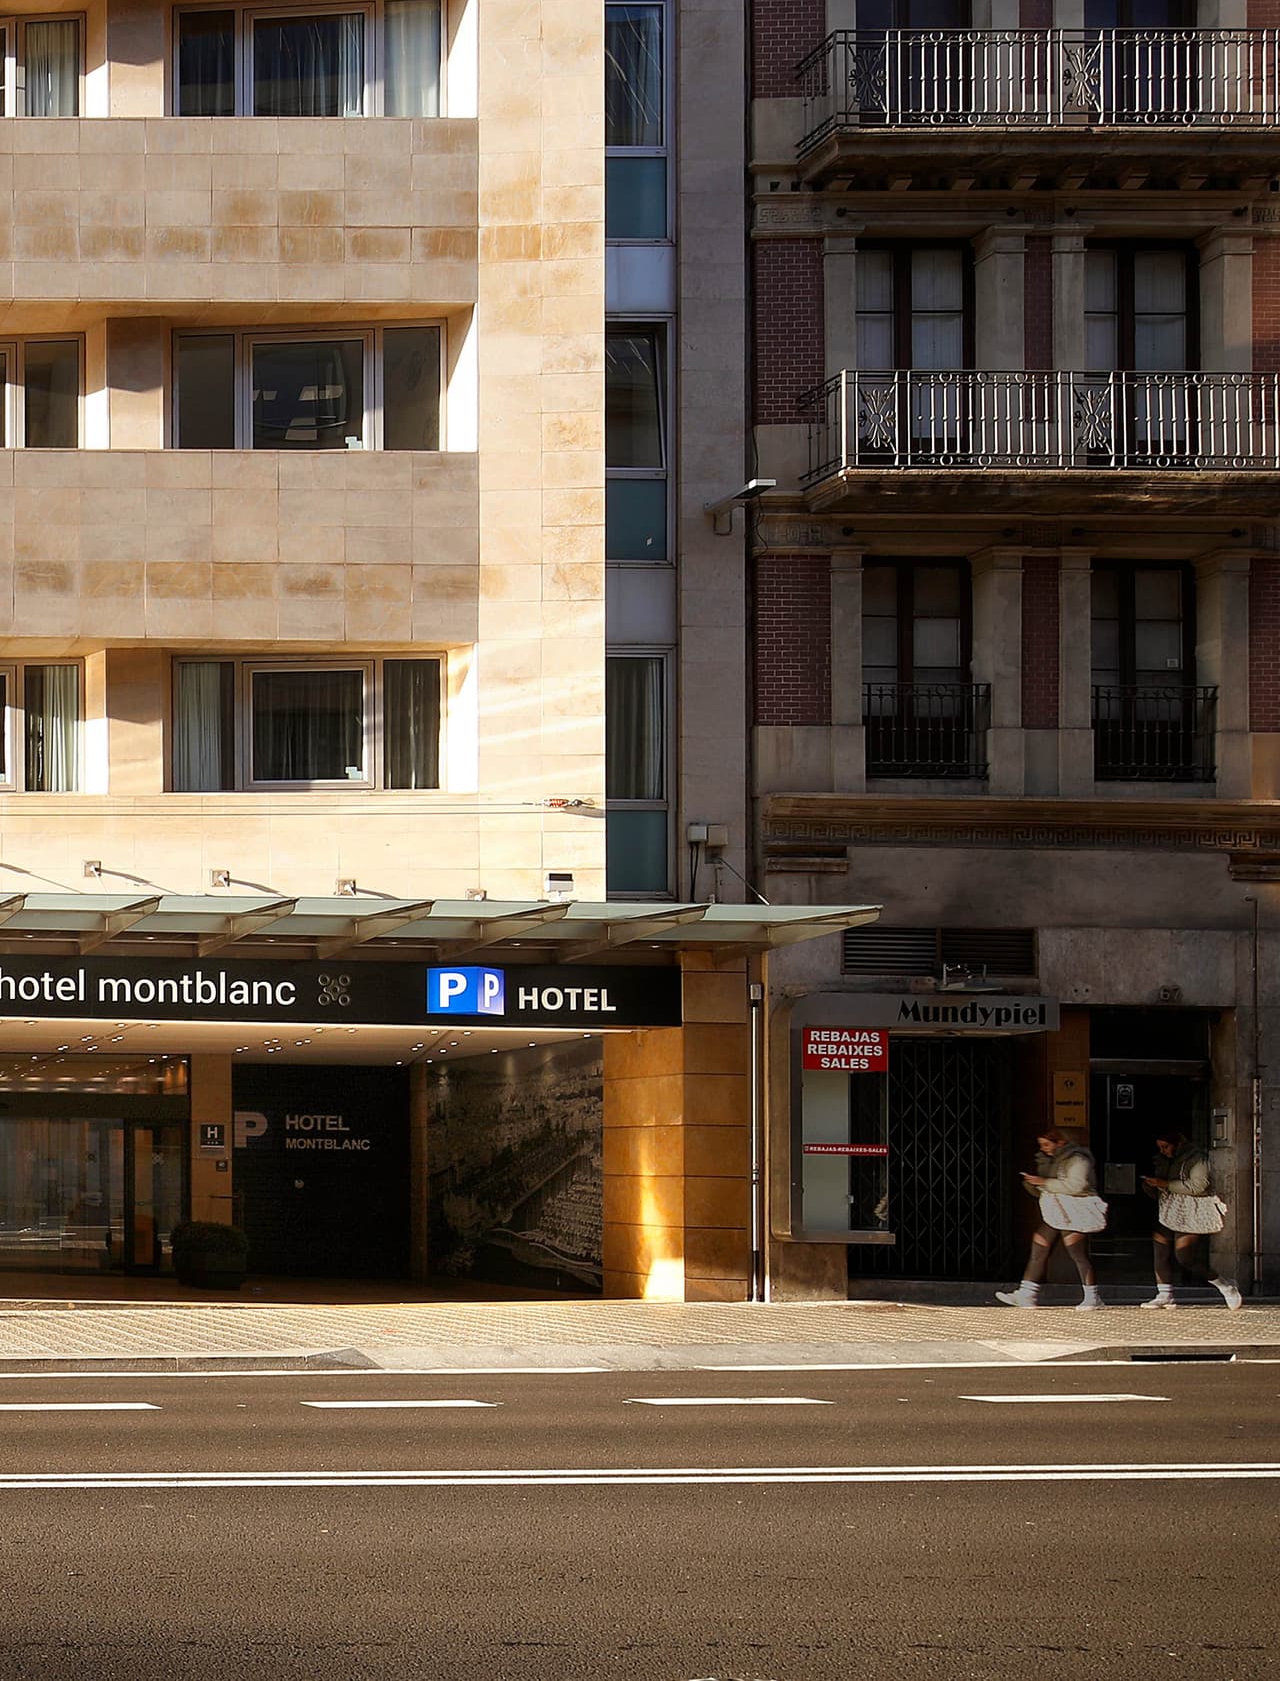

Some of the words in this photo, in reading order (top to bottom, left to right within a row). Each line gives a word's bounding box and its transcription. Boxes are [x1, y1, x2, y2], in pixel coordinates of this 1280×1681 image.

[98, 971, 296, 1005] montblanc
[439, 972, 467, 1008] P
[484, 973, 500, 1008] P
[518, 986, 617, 1011] HOTEL
[897, 999, 1046, 1026] Mundypiel
[810, 1030, 880, 1043] REBAJAS
[807, 1044, 883, 1056] REBAIXES
[820, 1057, 869, 1069] SALES
[207, 1126, 218, 1139] H
[234, 1111, 269, 1148] P
[286, 1114, 351, 1131] HOTEL
[285, 1138, 371, 1151] MONTBLANC
